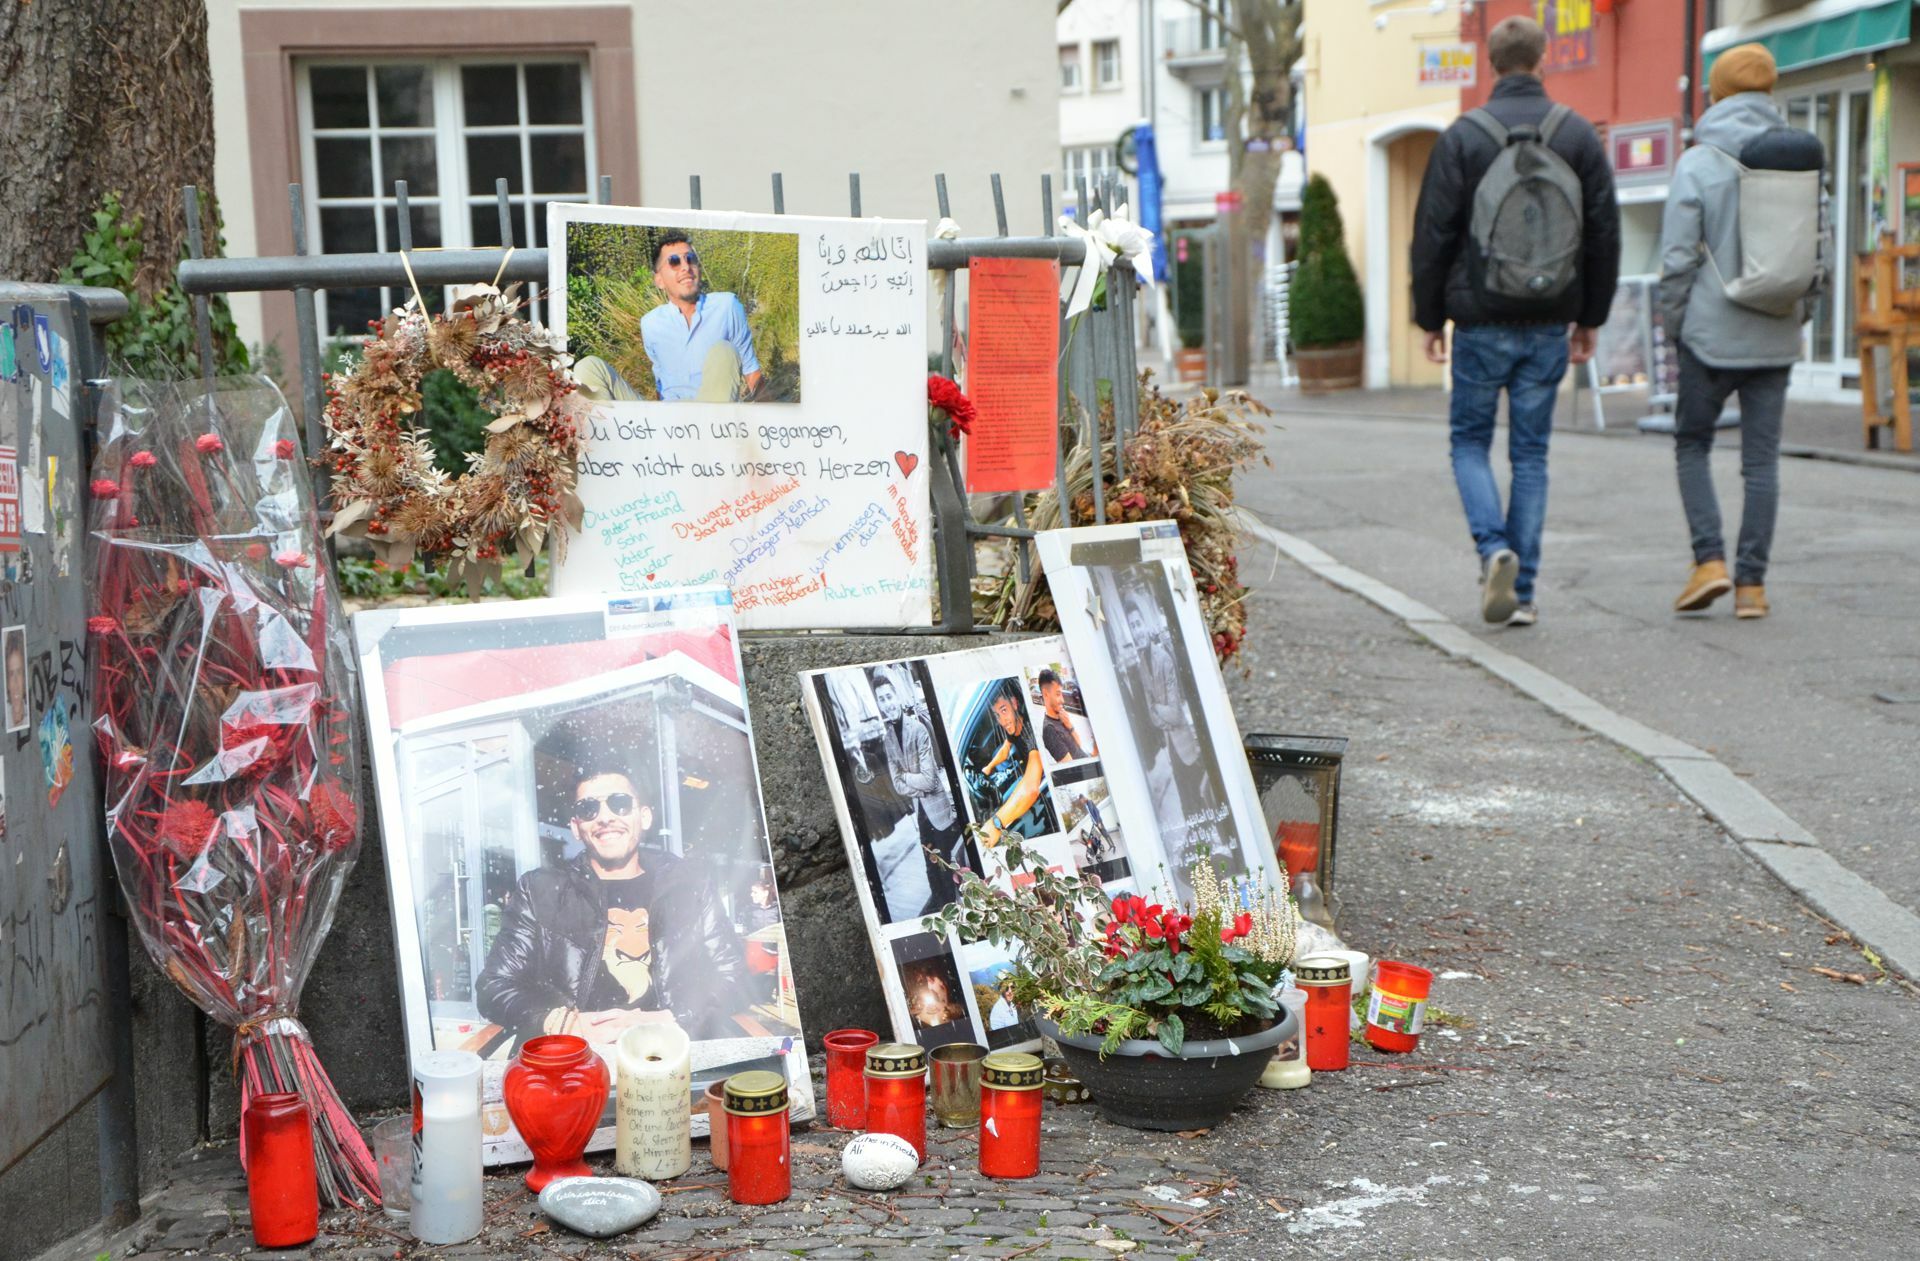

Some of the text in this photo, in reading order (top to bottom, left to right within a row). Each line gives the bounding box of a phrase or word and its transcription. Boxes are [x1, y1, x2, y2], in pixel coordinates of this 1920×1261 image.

[613, 416, 657, 441] bist
[663, 423, 701, 441] von
[711, 421, 749, 439] uns
[758, 425, 848, 450] gegangen,
[576, 451, 891, 480] aber nicht aus unseren Herzen
[583, 489, 678, 528] Du warst ein
[600, 500, 686, 546] guter Freund
[671, 490, 762, 540] Du warst eine
[694, 517, 735, 541] starke
[723, 496, 831, 587] gutherziger Mensch
[729, 498, 808, 555] Du warst ein
[831, 502, 882, 554] vermissen
[614, 545, 656, 569] Vater
[618, 554, 674, 586] Bruder
[759, 574, 804, 596] ruhiger
[823, 584, 861, 602] Ruhe
[862, 583, 878, 596] in
[849, 1143, 865, 1155] Ali
